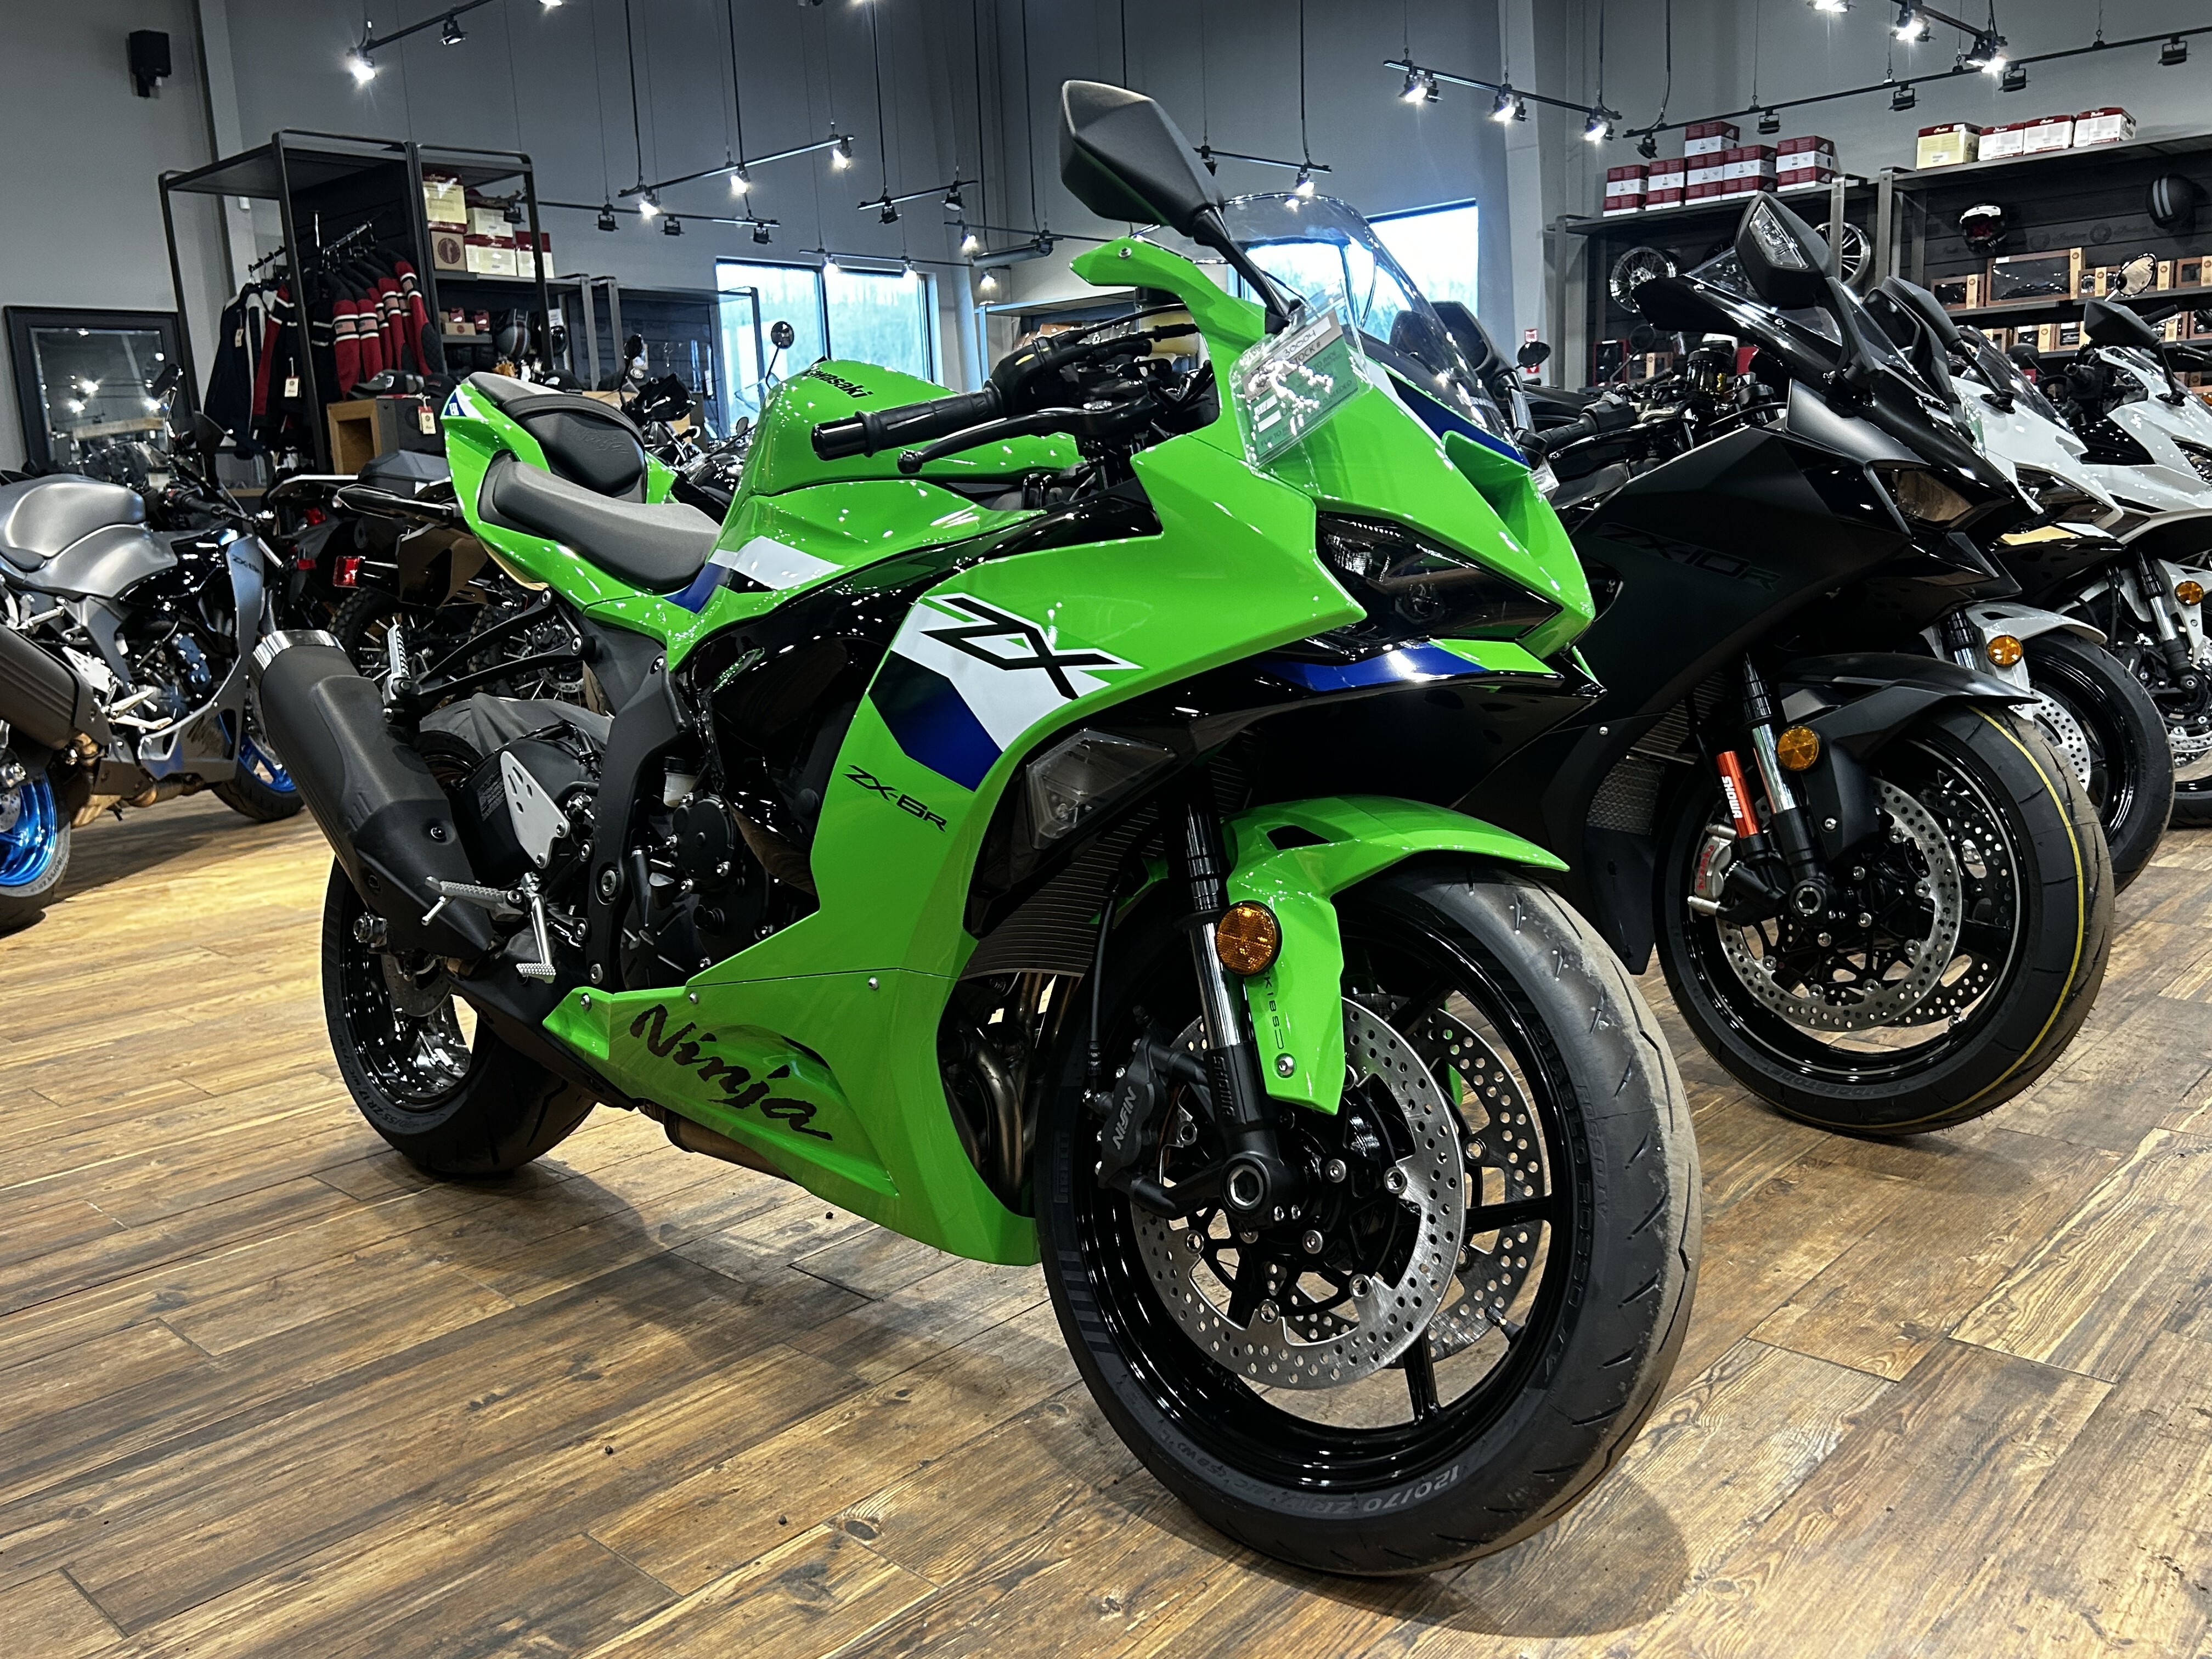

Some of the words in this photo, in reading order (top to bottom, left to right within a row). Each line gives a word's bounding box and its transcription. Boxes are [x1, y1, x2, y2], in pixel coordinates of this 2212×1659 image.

[1283, 330, 1316, 357] 30004
[1290, 344, 1316, 365] TOCK
[1594, 522, 1781, 591] ZX-10R
[919, 597, 1121, 701] ZX
[843, 765, 947, 832] ZX-6R
[1721, 776, 1743, 819] SHOWA
[1697, 844, 1715, 890] brembo
[1263, 977, 1280, 1028] KIBS
[630, 1004, 833, 1141] Ninja
[1111, 1086, 1137, 1150] NISSIN
[1363, 1464, 1458, 1511] 120/70
